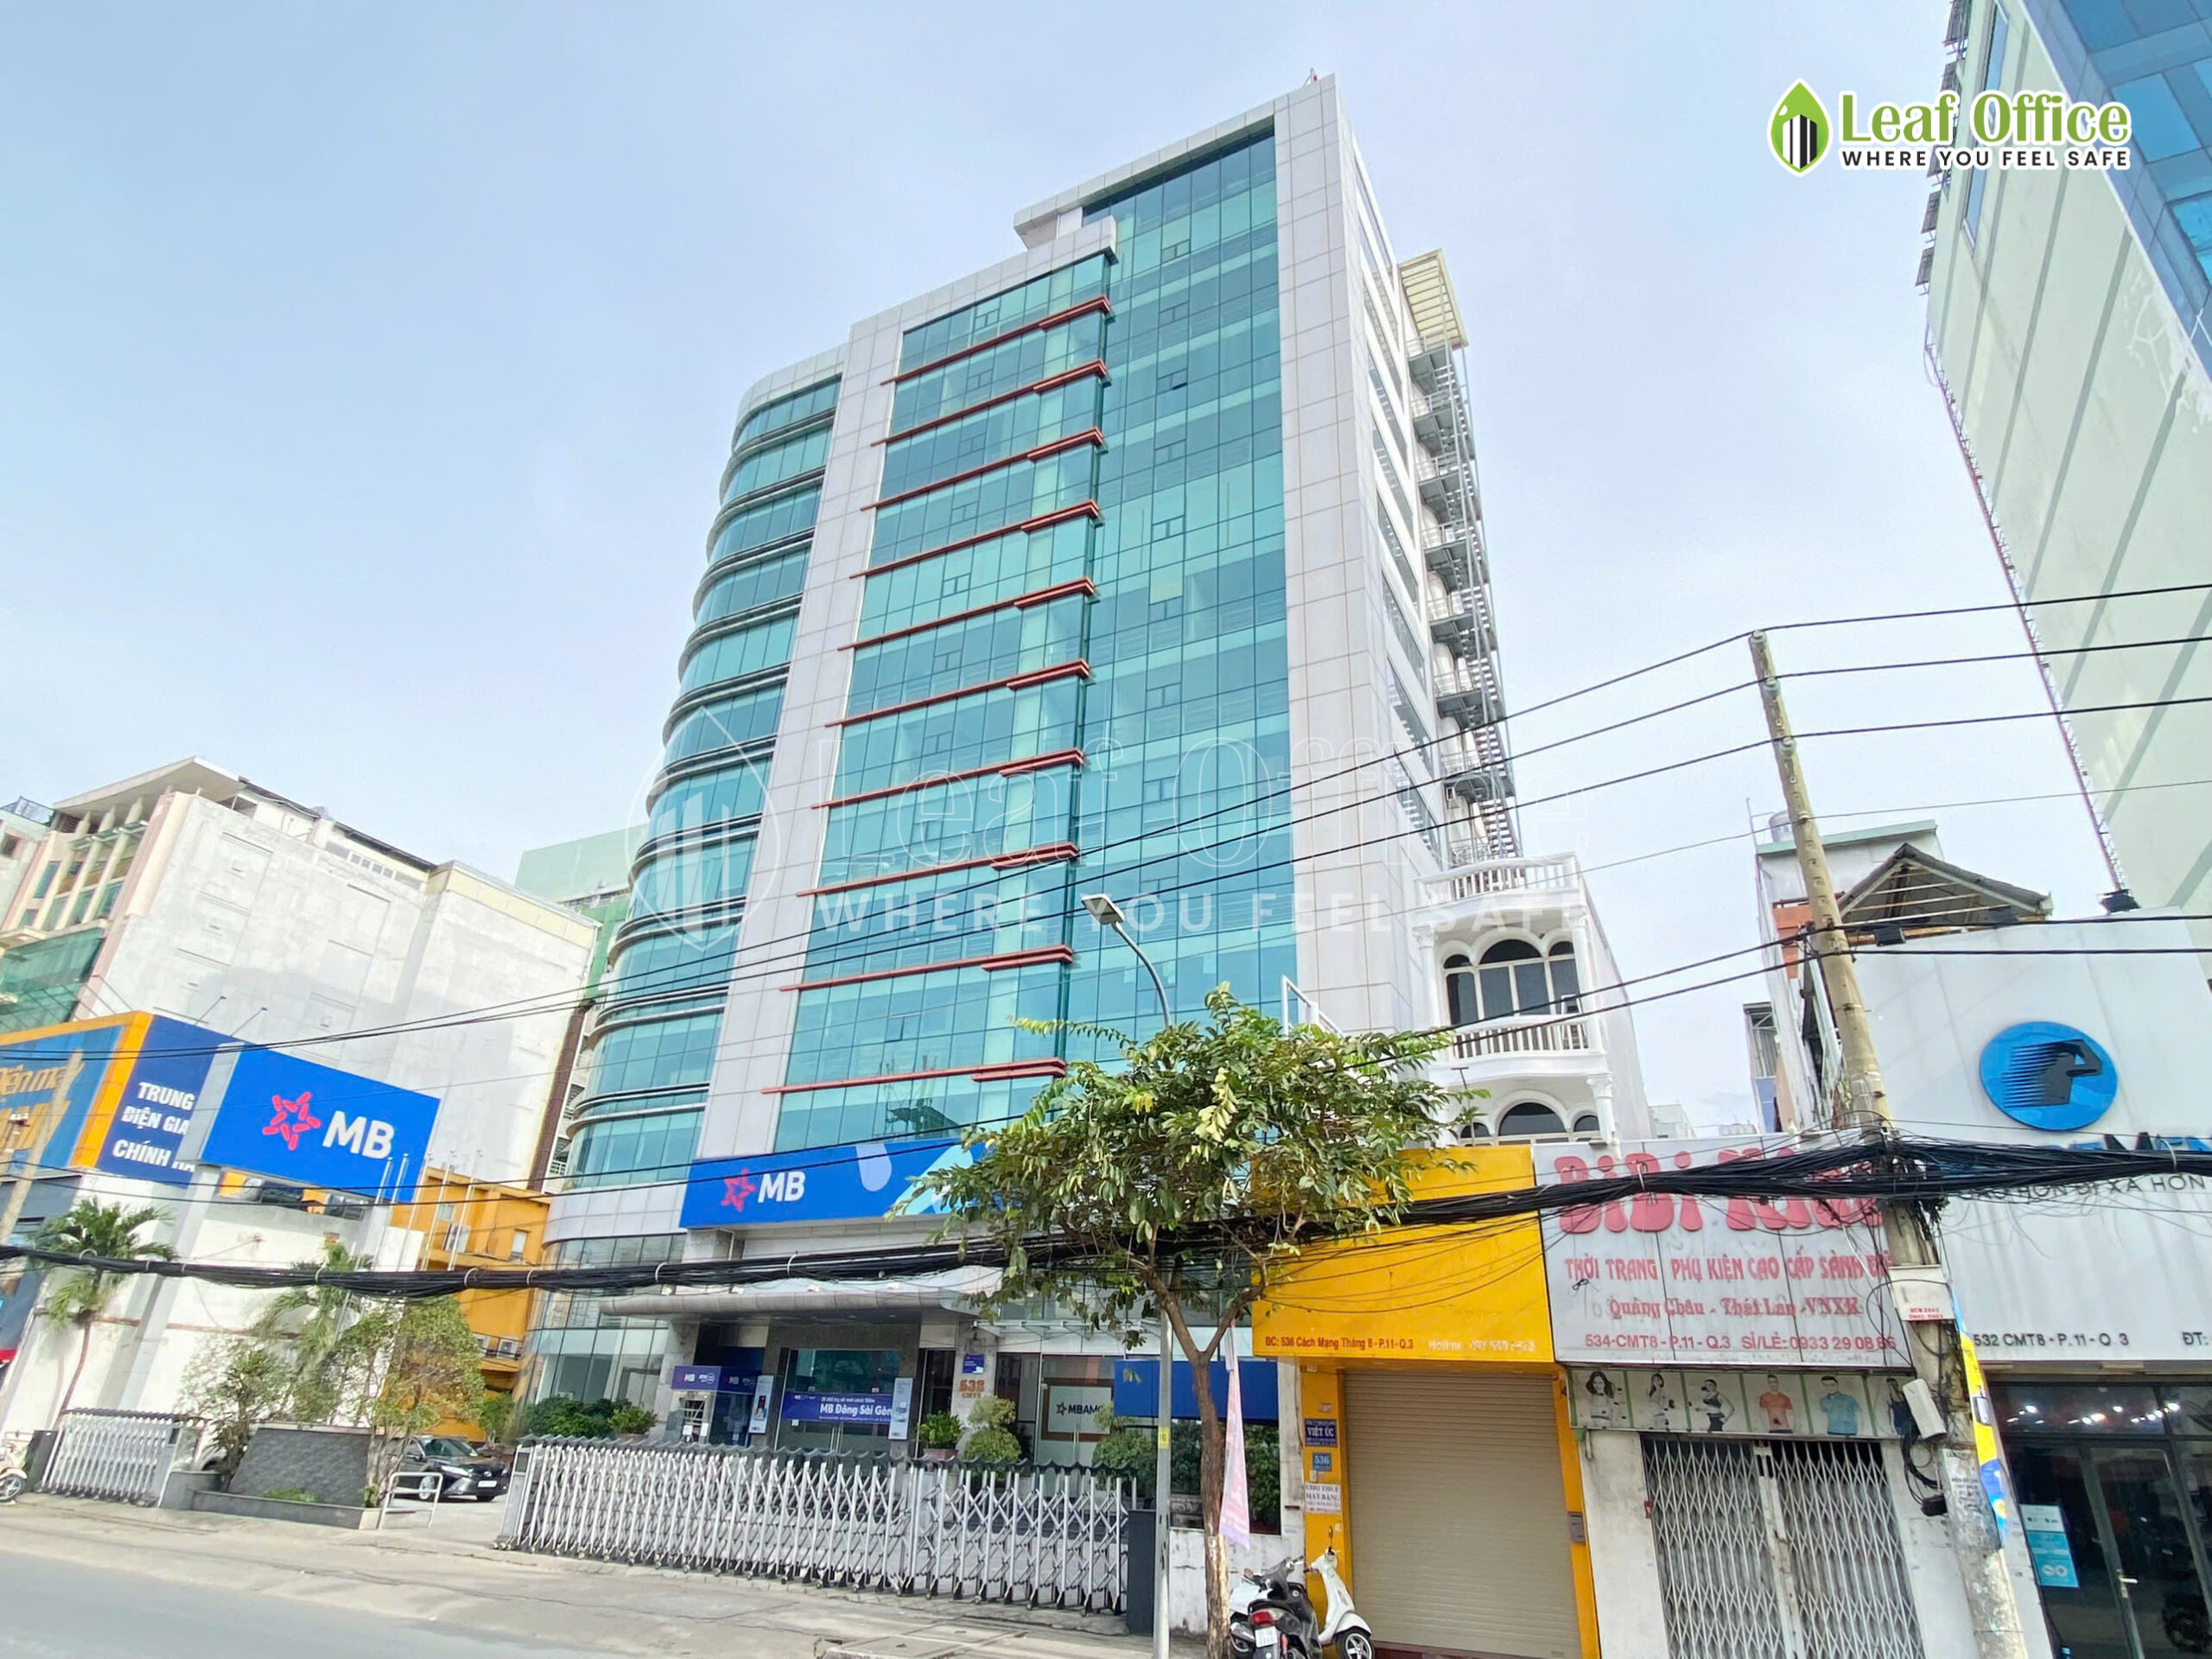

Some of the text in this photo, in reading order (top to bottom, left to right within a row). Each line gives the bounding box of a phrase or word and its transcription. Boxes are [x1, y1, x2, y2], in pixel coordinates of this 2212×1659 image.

[137, 1082, 195, 1110] TRUNG
[121, 1105, 162, 1130] ĐIỆN
[323, 1110, 395, 1159] MB
[112, 1139, 171, 1167] CHÍNH
[758, 1171, 805, 1203] MB
[1564, 1253, 1599, 1281] THỜI
[1605, 1258, 1658, 1281] TRANG
[1671, 1258, 1702, 1283] PHỤ
[1707, 1254, 1744, 1282] KIỆN
[1747, 1256, 1779, 1281] CAO
[1785, 1245, 1815, 1280] CẤP
[1819, 1249, 1865, 1281] SÀNH
[1664, 1298, 1705, 1316] Châu
[1281, 1337, 1294, 1347] 536
[1296, 1336, 1316, 1348] Cách
[1974, 1333, 1999, 1346] 532
[2003, 1333, 2046, 1346] CMT8
[820, 1403, 834, 1414] MB
[835, 1404, 858, 1416] Đông
[860, 1405, 873, 1415] Sài
[1315, 1455, 1330, 1465] 536
